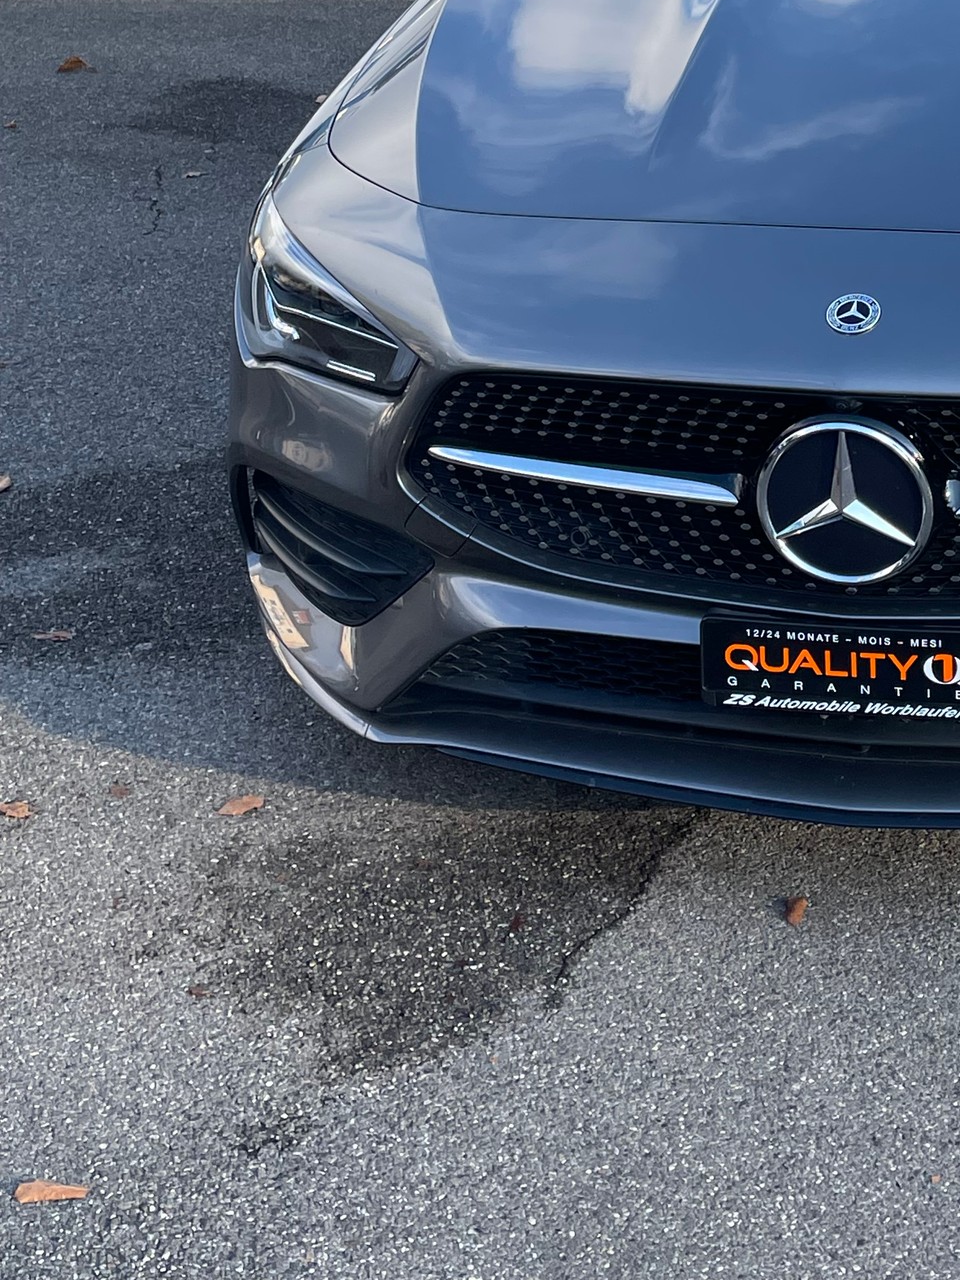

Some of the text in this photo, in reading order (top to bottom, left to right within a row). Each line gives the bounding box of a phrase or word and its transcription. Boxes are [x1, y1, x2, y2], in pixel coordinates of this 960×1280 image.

[745, 628, 781, 640] 12/24
[786, 631, 840, 644] MONATE
[857, 636, 892, 647] MOIS
[909, 638, 943, 649] MESI
[724, 643, 919, 681] QUALITY
[722, 693, 757, 706] ZS
[754, 695, 861, 714] Automobile
